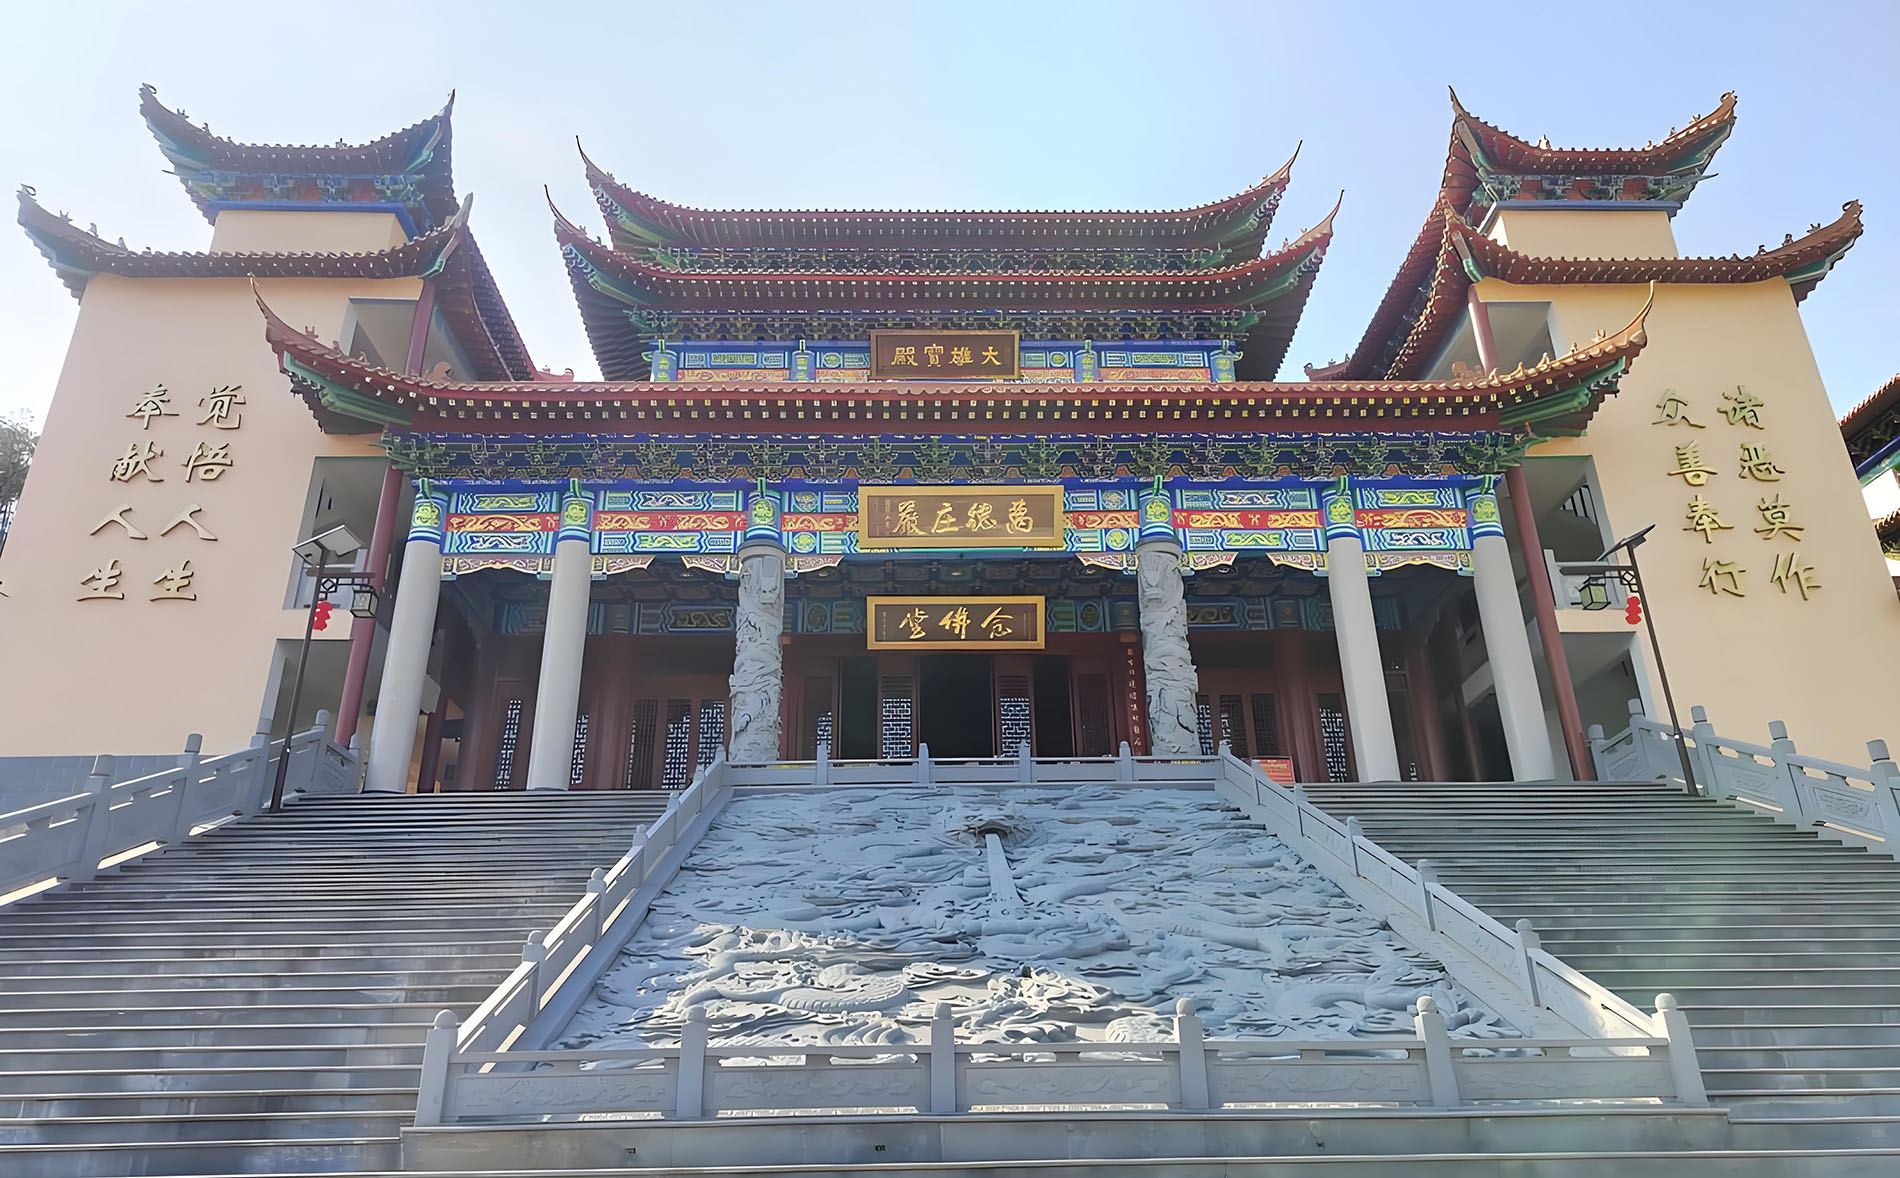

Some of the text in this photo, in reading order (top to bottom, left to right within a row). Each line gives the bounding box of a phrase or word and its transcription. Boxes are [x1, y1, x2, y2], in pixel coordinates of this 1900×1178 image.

[77, 383, 180, 602] 奉献人生
[150, 384, 247, 602] 觉悟人生
[1652, 387, 1747, 598] 众善奉行
[1717, 385, 1822, 601] 诸恶莫作
